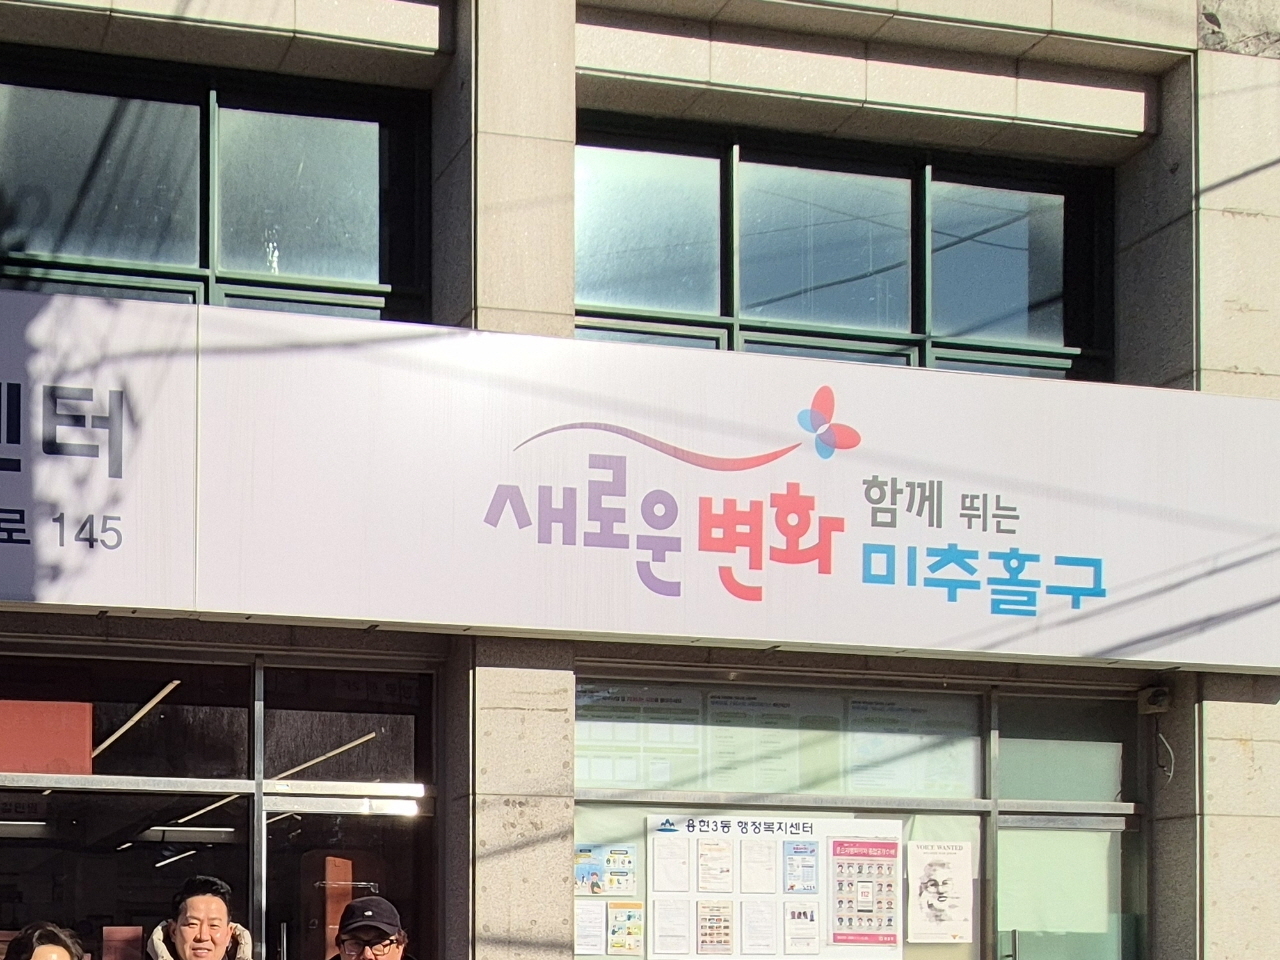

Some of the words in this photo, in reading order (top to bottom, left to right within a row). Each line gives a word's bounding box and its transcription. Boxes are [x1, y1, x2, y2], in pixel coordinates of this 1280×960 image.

[51, 512, 122, 550] 145
[484, 454, 681, 597] 새로운
[698, 482, 845, 602] 변화
[862, 475, 944, 529] 함께
[959, 495, 1020, 535] 뛰는
[862, 543, 1106, 617] 미추홀구
[685, 818, 732, 833] 용현3동
[737, 820, 814, 835] 행정복지센터
